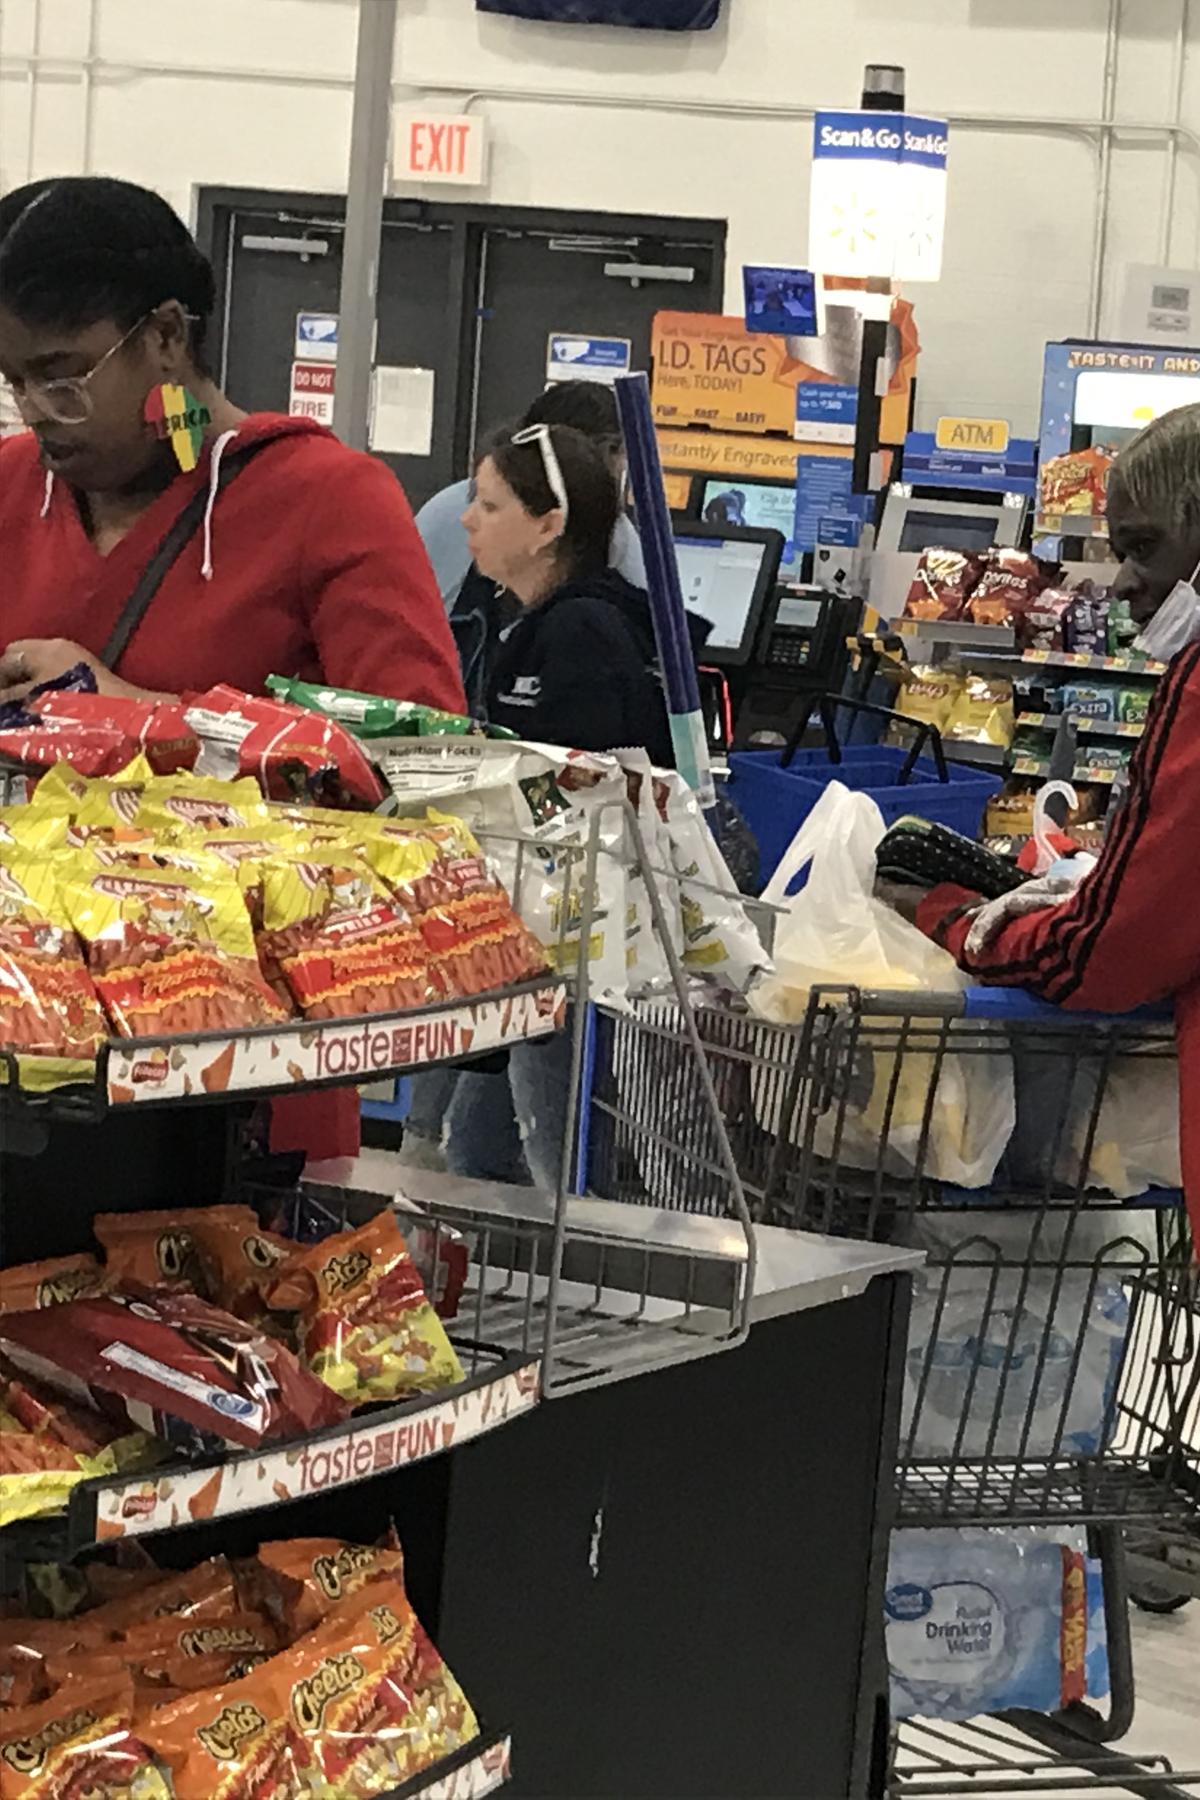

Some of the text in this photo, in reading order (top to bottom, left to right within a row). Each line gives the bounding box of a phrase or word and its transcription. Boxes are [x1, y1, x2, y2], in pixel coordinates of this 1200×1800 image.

[409, 122, 471, 174] EXIT
[820, 125, 900, 149] Scan&Go
[701, 342, 766, 376] TAGS
[1068, 351, 1130, 368] TASTE
[1136, 355, 1155, 370] IT
[1163, 358, 1200, 373] AND
[295, 373, 332, 388] DO NOT
[694, 375, 743, 393] TODAY!
[292, 400, 327, 417] FIRE
[951, 424, 994, 445] ATM
[314, 1022, 391, 1076] taste
[414, 1019, 458, 1062] FUN
[299, 1433, 374, 1490] taste
[394, 1417, 440, 1462] FUN
[926, 1621, 992, 1639] Drinking
[290, 1652, 367, 1734] Cheetos
